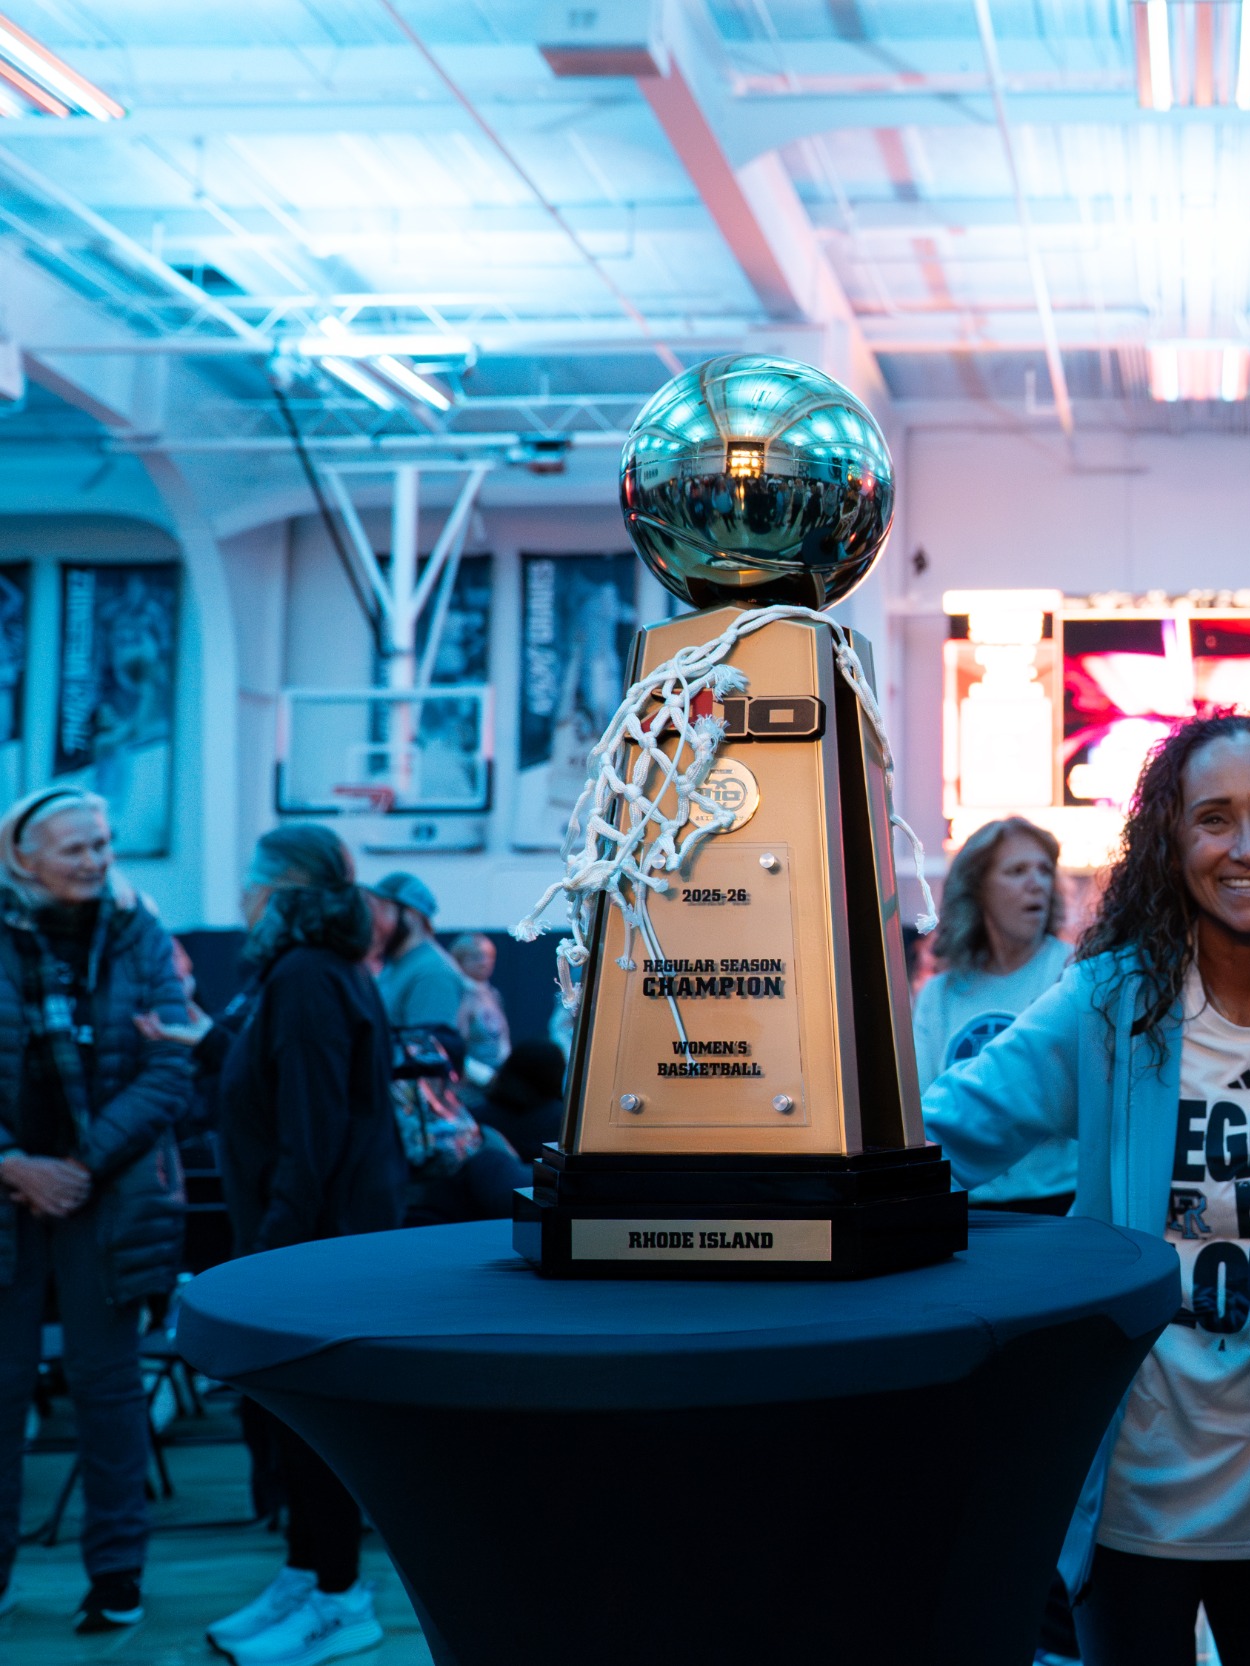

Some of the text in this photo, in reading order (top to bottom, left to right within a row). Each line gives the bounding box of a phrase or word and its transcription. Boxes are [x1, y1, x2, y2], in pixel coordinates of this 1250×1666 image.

[682, 888, 748, 903] 2025-26
[643, 958, 783, 973] REGULAR SEASON
[642, 976, 783, 998] CHAMPION
[672, 1041, 748, 1055] WOMEN'S
[657, 1062, 763, 1077] BASKETBALL
[628, 1231, 774, 1249] RHODE ISLAND
